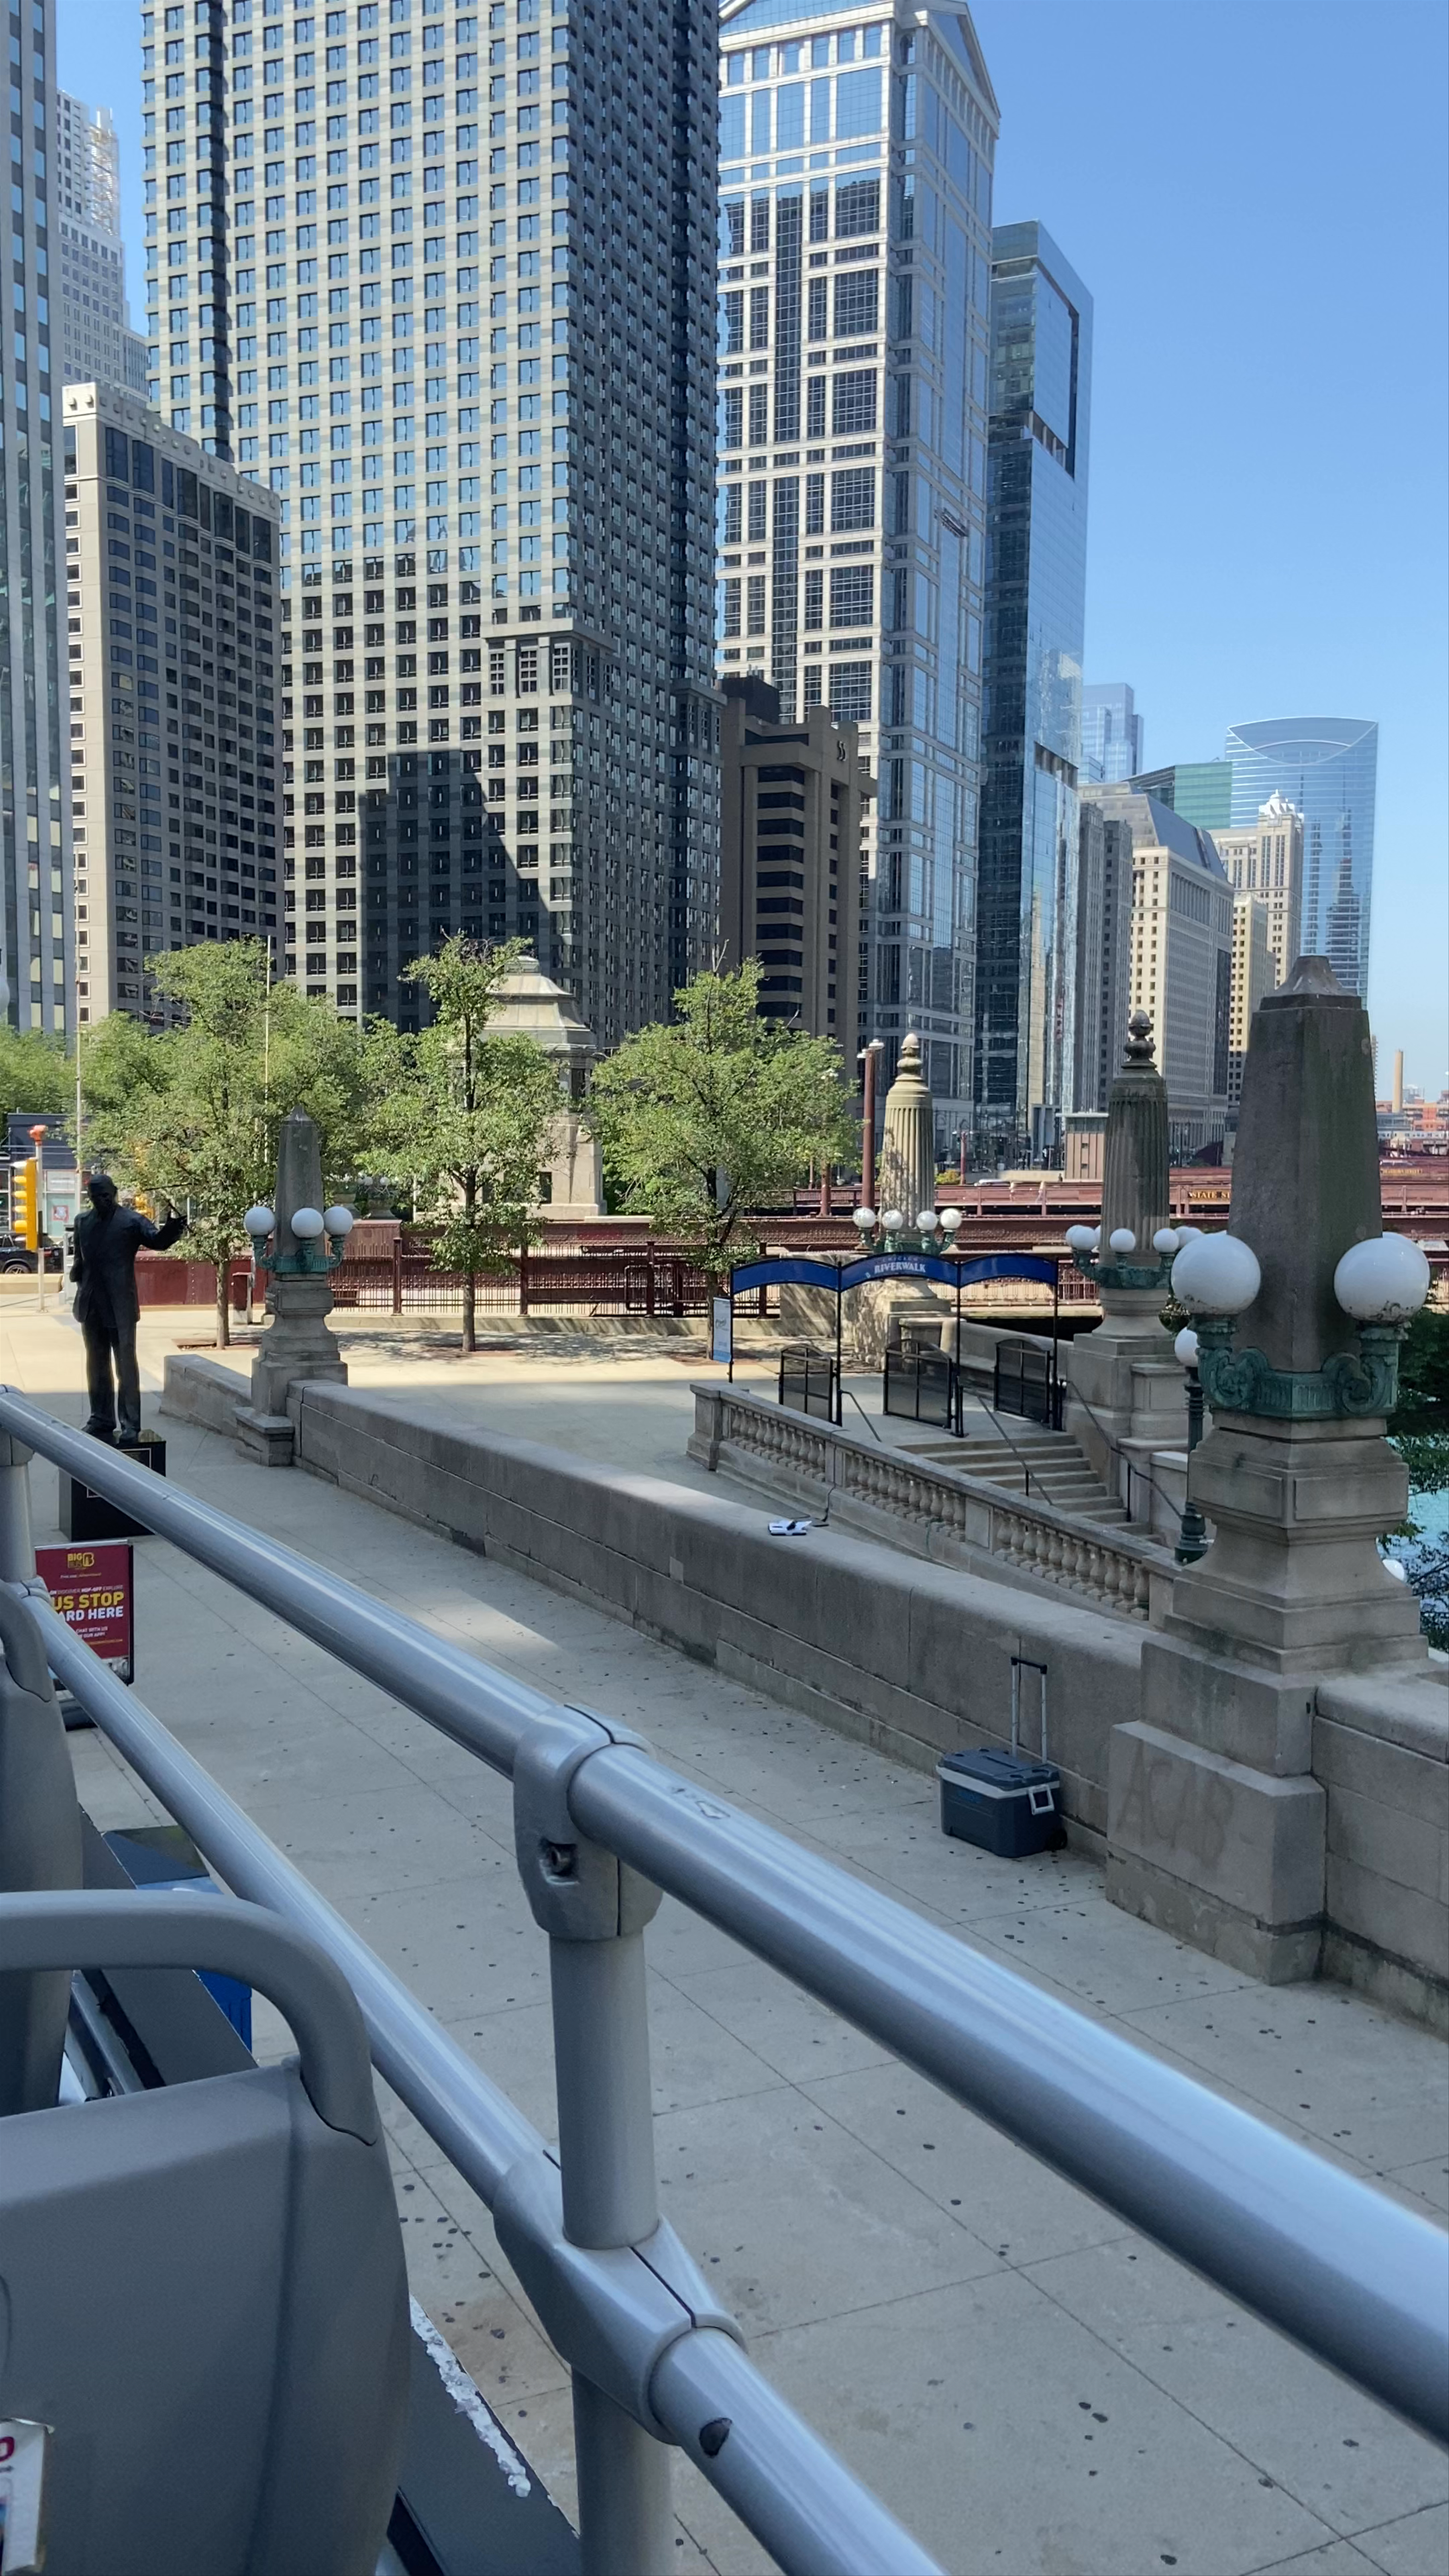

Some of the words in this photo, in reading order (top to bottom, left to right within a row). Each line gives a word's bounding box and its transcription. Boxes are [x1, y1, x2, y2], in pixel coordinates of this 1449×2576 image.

[874, 1262, 926, 1274] RIVERWALK
[68, 1553, 82, 1561] BIG
[52, 1595, 74, 1610] US
[78, 1591, 124, 1608] STOP
[88, 1606, 123, 1620] HERE
